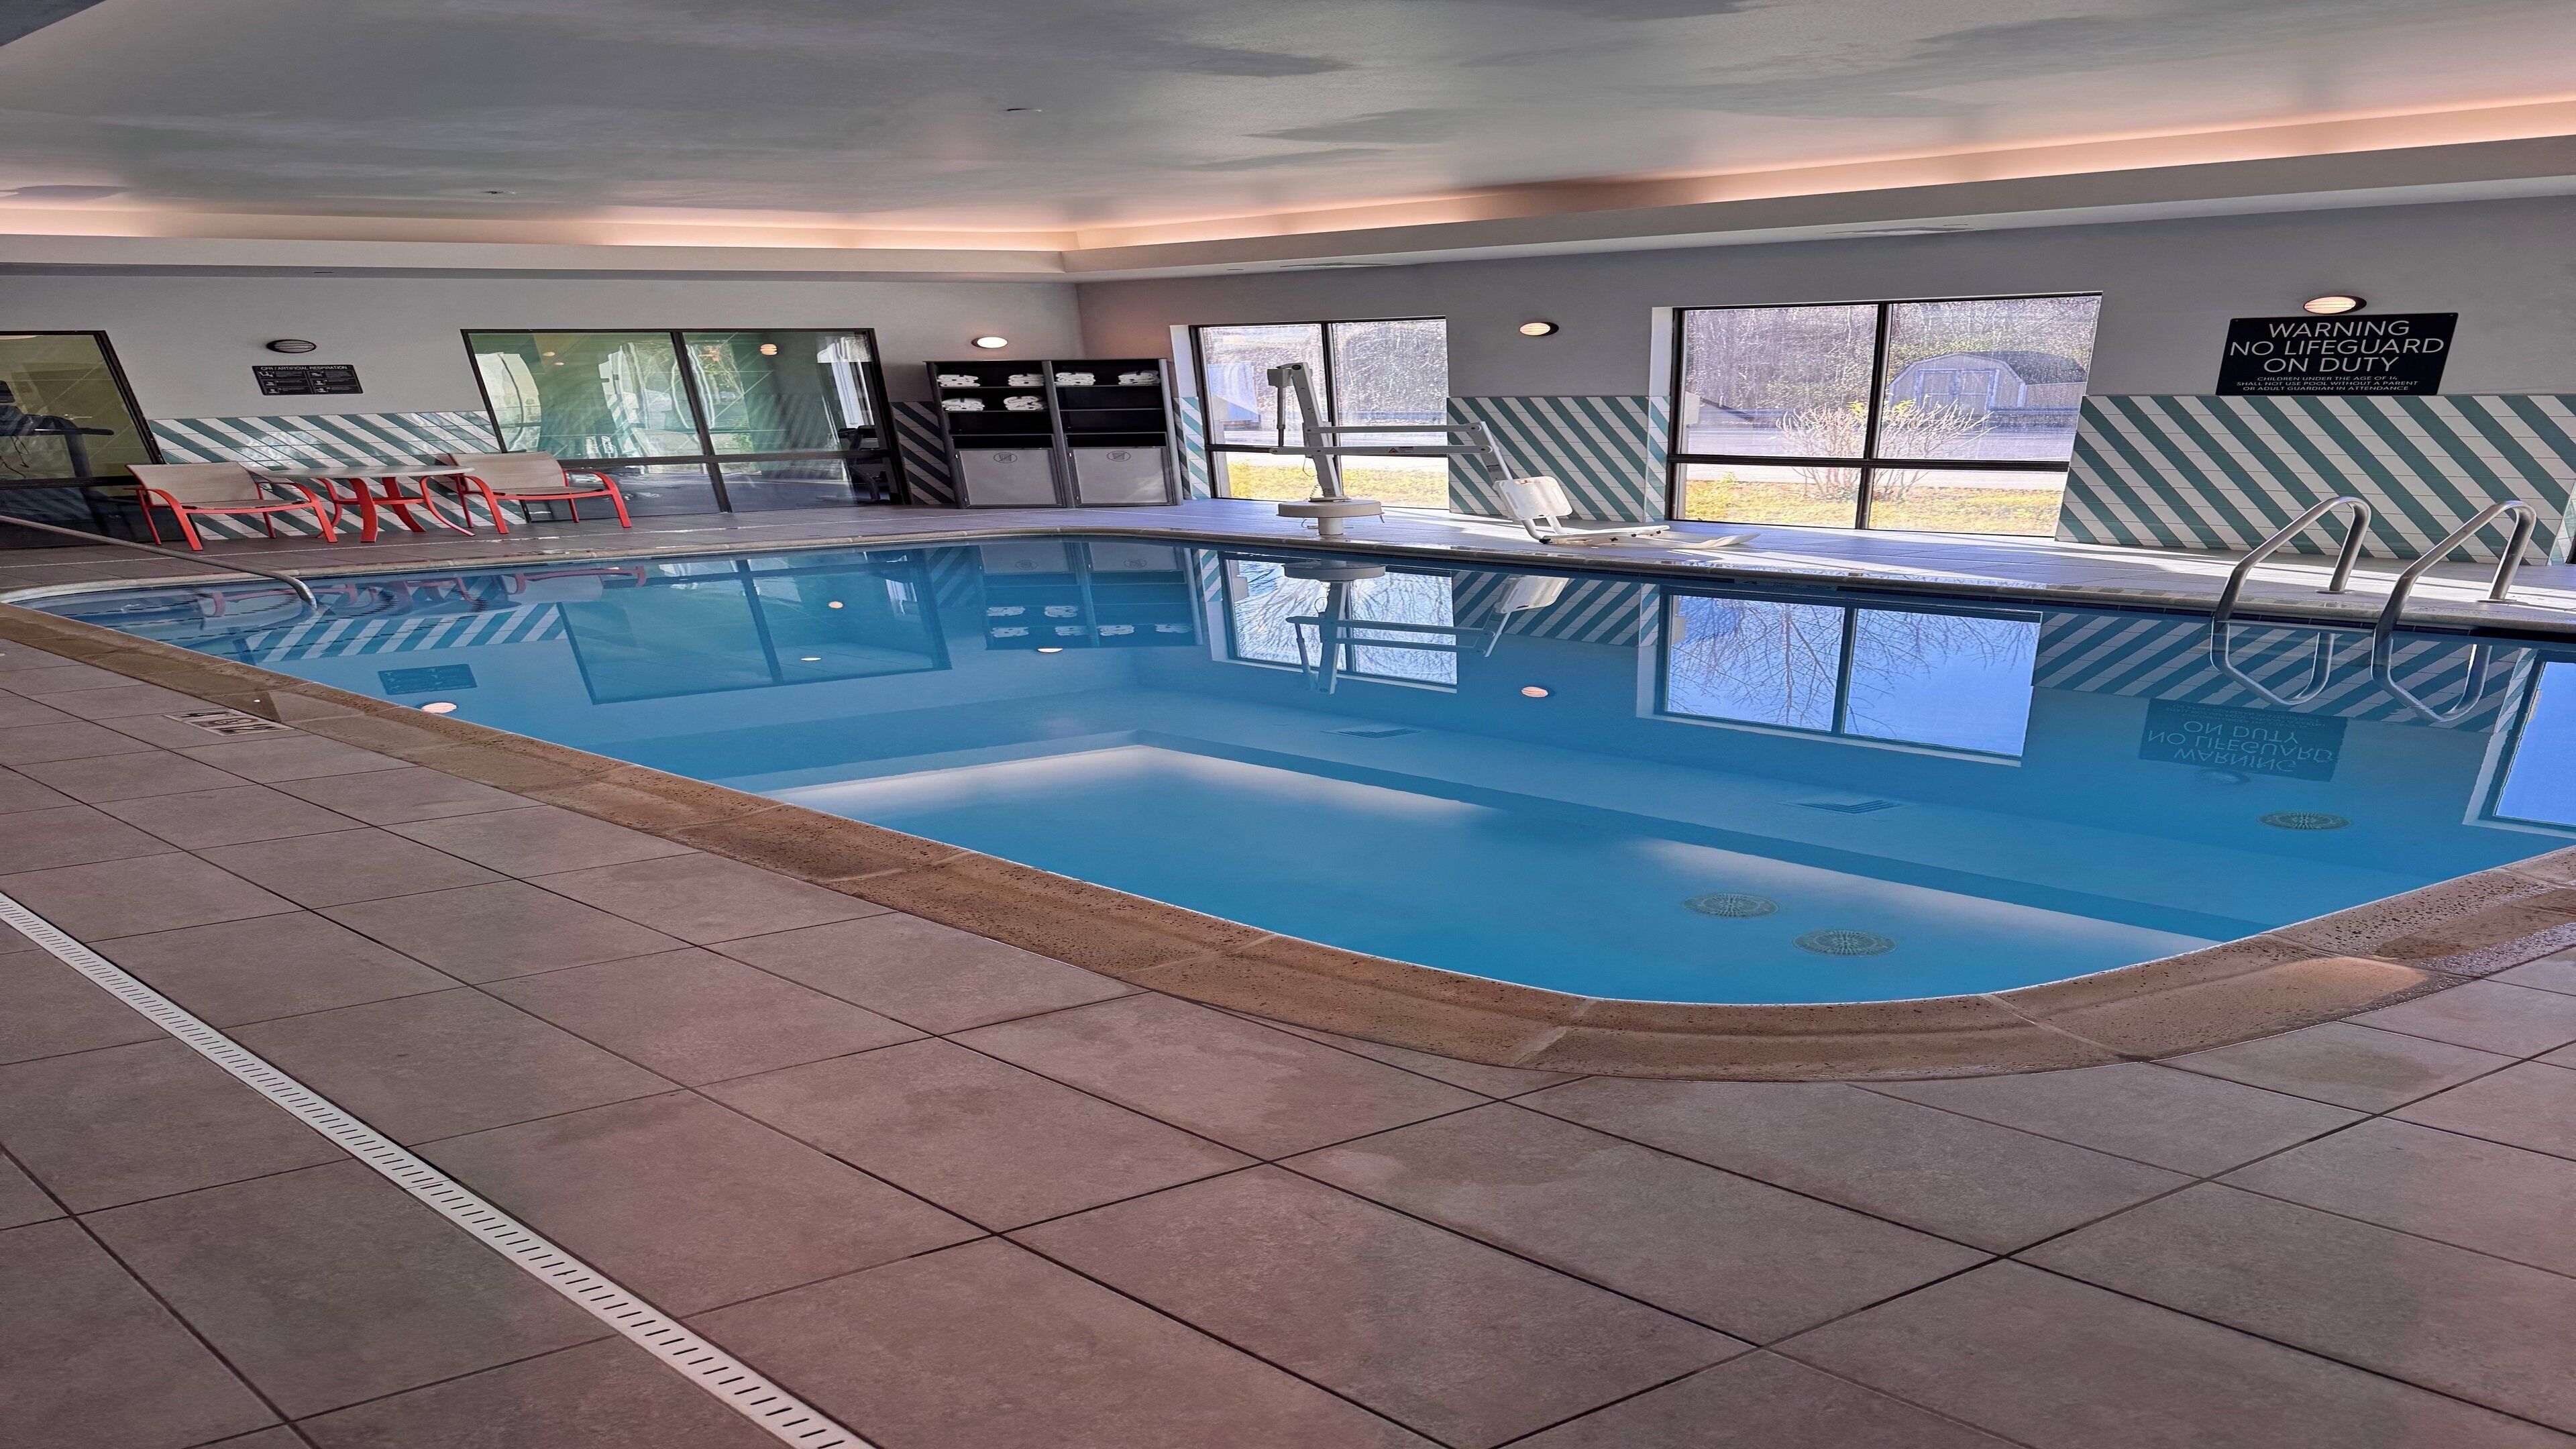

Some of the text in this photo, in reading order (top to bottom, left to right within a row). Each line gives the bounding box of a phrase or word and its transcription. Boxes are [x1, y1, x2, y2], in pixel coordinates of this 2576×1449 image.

[2269, 321, 2410, 337] WARNING
[2230, 337, 2445, 356] NO LIFEGUARD
[2263, 356, 2400, 373] ON DUTY
